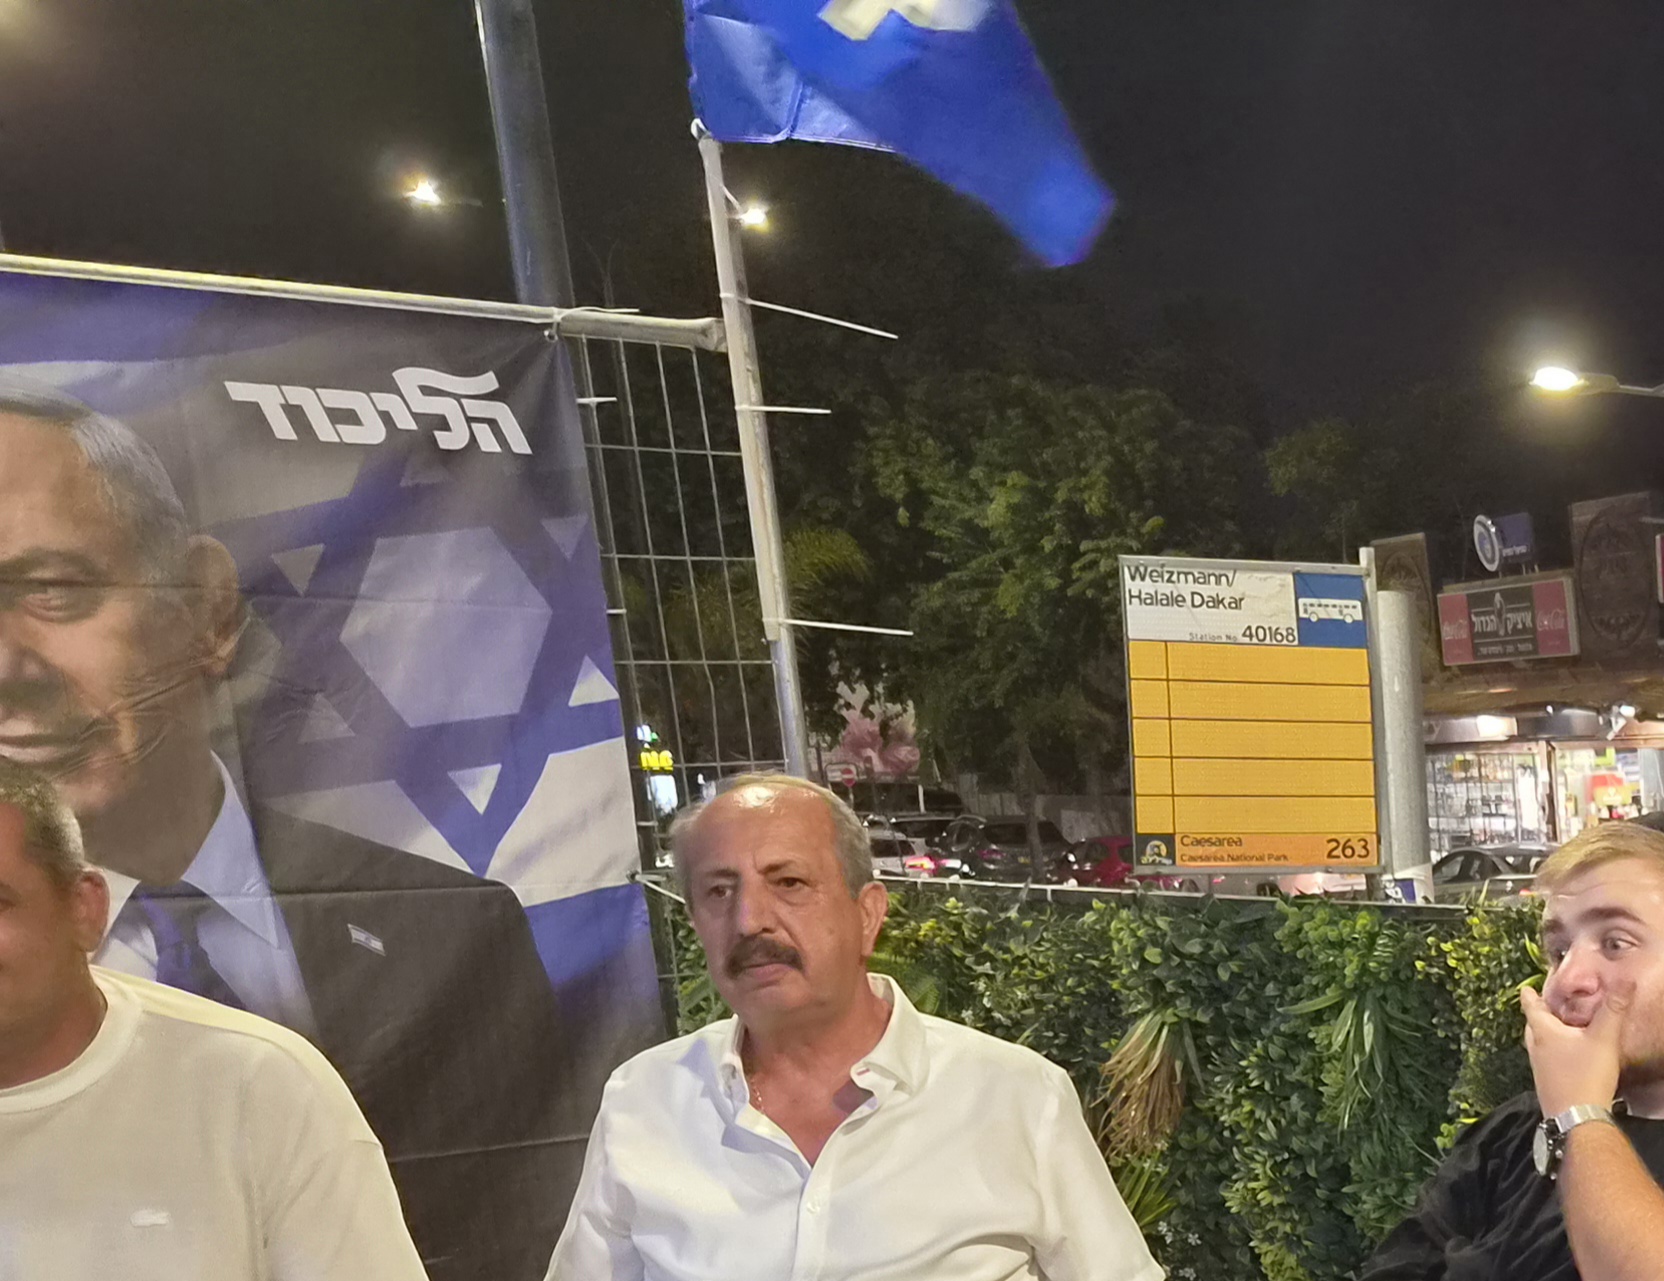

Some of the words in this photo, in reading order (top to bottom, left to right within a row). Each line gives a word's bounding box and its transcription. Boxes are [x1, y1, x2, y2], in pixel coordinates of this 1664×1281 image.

[224, 367, 532, 454] הליכוד
[1126, 564, 1237, 587] Weizmann/
[1128, 589, 1187, 608] Halale
[1190, 591, 1245, 610] Dakar
[1241, 625, 1297, 643] 40168
[1180, 834, 1243, 848] Caesarea
[1326, 838, 1370, 860] 263
[1180, 853, 1225, 862] Caesarea
[1227, 853, 1265, 862] National
[1267, 854, 1289, 862] Park
